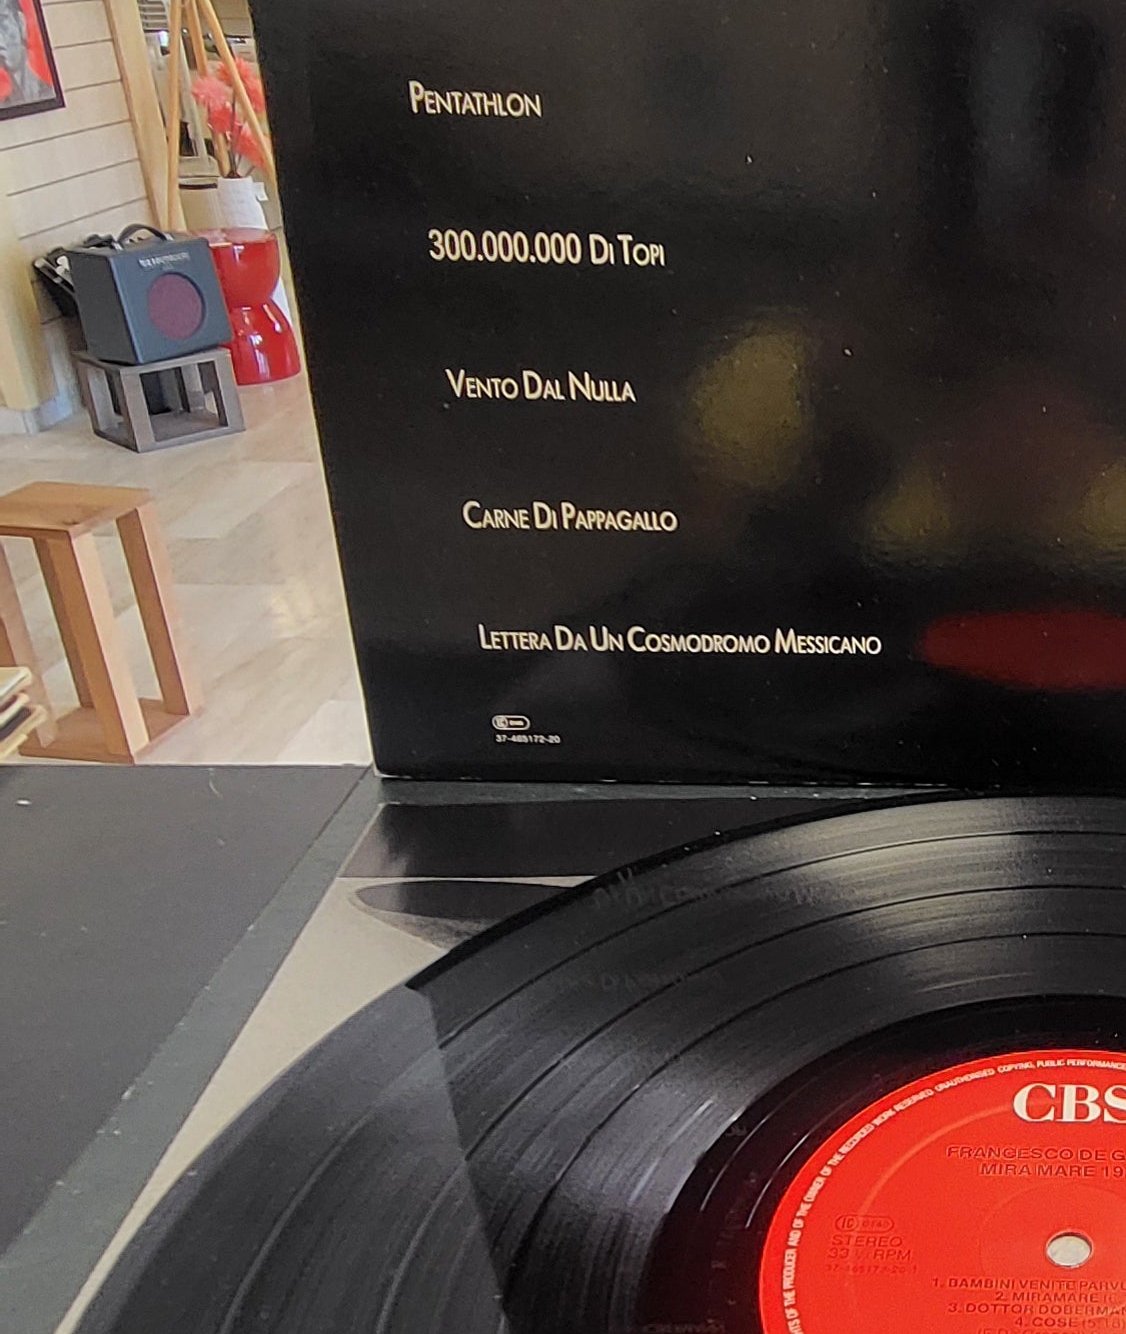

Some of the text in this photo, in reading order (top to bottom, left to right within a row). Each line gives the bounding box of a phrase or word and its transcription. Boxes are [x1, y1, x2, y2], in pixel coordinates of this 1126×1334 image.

[408, 80, 542, 117] PENTATHLON
[428, 228, 665, 267] 300.000.000 DI TOPI
[445, 368, 637, 403] VENTO DAL NULLA
[462, 499, 679, 532] CARNE DI PAPPAGALLO
[477, 623, 883, 655] LETTERA DA UN COSMODROMO MESSICANO
[946, 1145, 1074, 1161] FRANCESCO
[1079, 1149, 1107, 1162] DE
[979, 1163, 1032, 1176] MIRA
[1037, 1164, 1096, 1177] MARE
[832, 1234, 903, 1247] STEREO
[873, 1249, 911, 1261] RPM
[948, 1278, 1015, 1289] BAMBINI
[1019, 1279, 1076, 1291] VENITE
